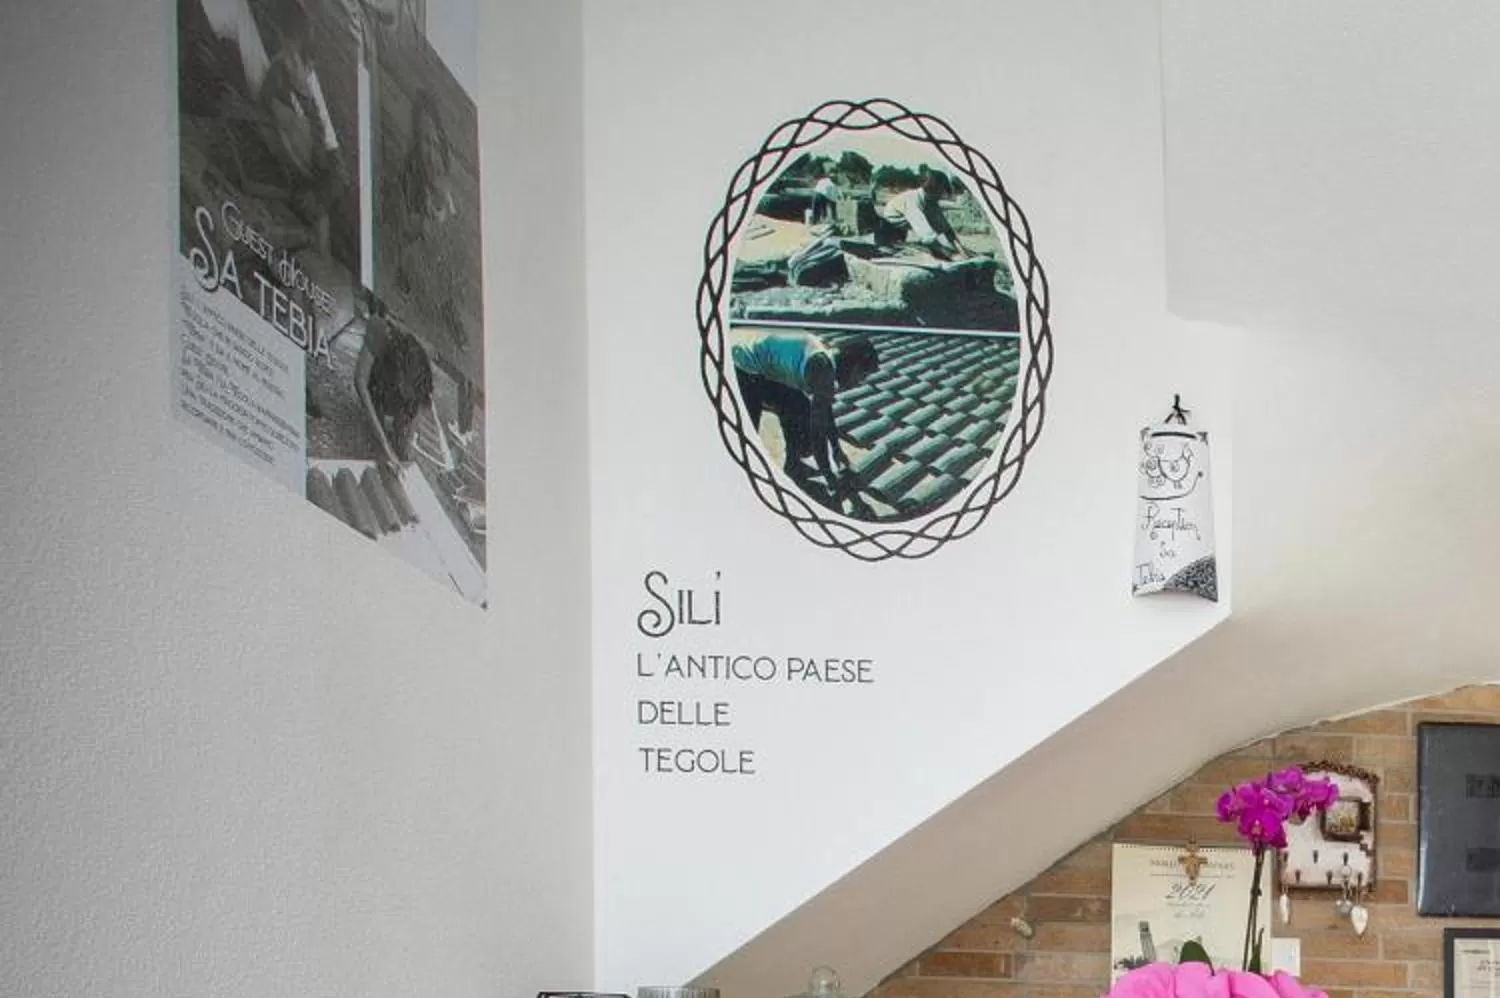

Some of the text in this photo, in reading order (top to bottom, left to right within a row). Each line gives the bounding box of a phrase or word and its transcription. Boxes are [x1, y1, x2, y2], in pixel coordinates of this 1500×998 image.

[189, 206, 243, 300] SA
[636, 652, 875, 684] L'ANTICO PAESE
[637, 699, 732, 727] DELLE
[638, 747, 757, 775] TEGOLE
